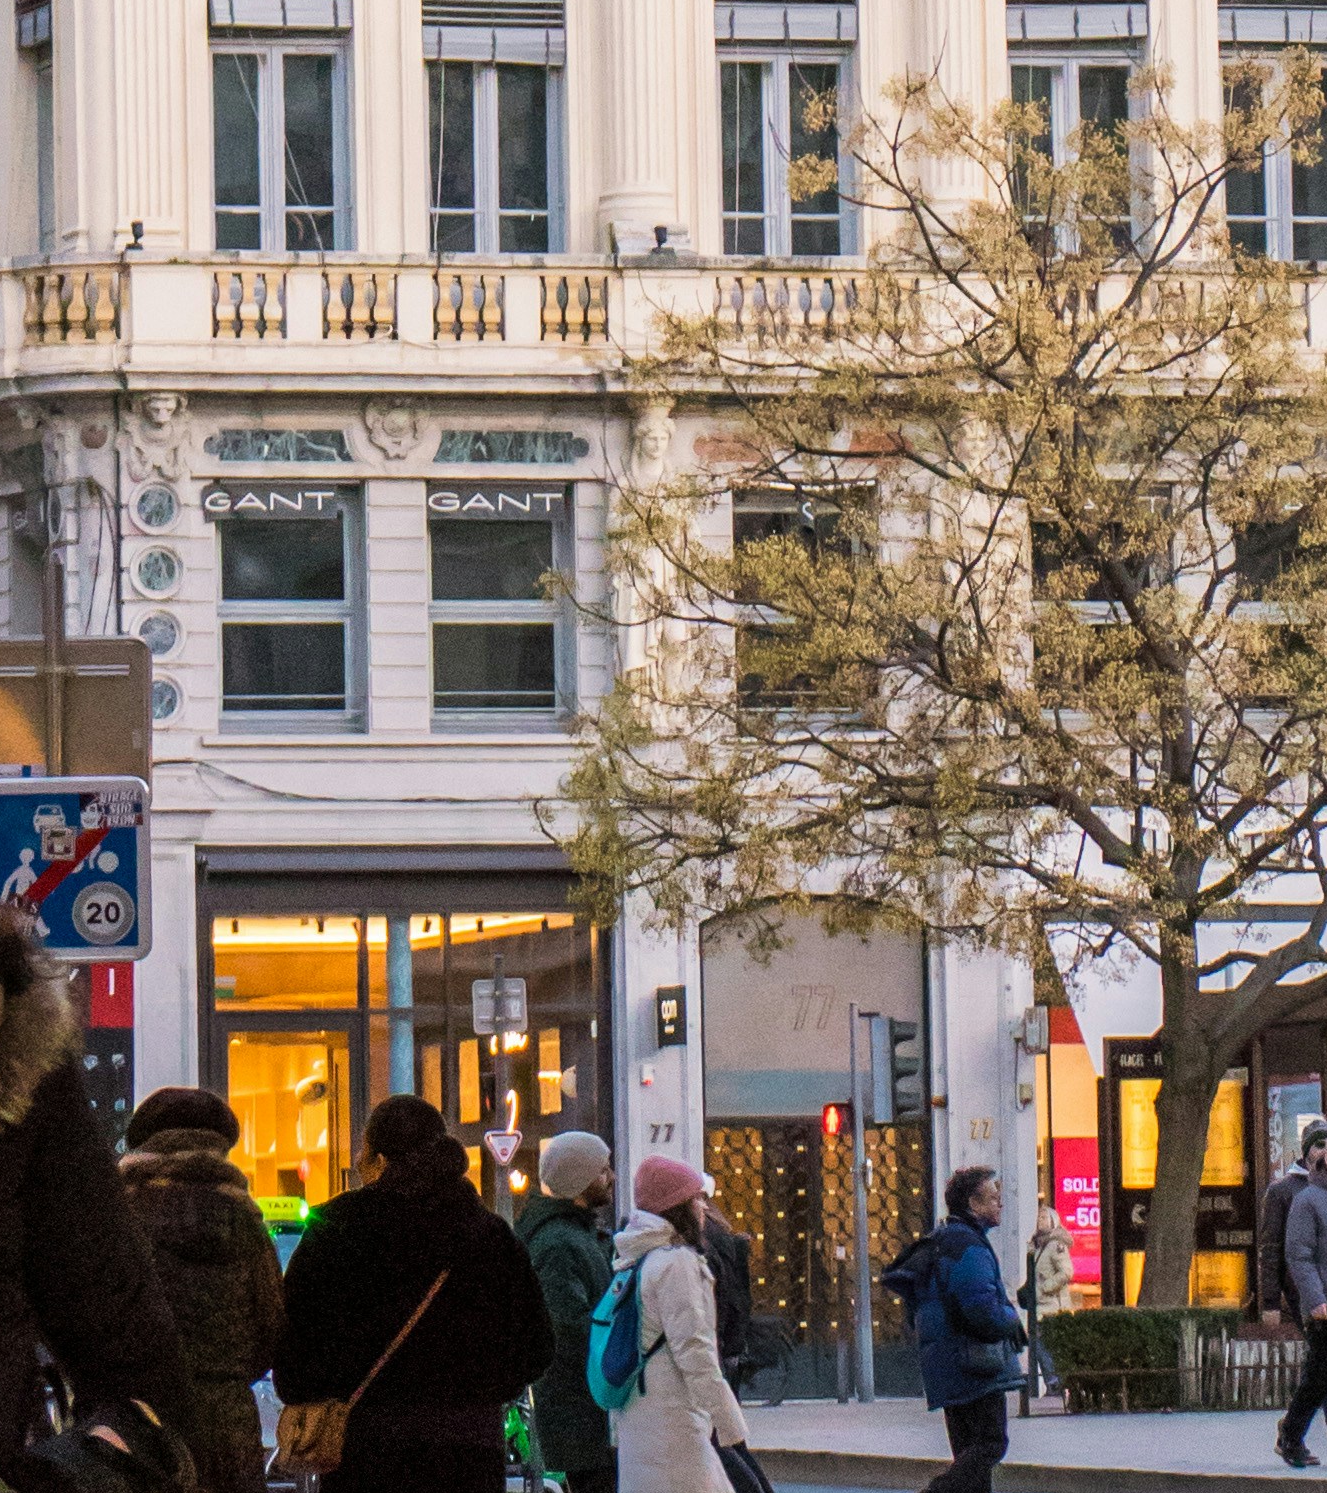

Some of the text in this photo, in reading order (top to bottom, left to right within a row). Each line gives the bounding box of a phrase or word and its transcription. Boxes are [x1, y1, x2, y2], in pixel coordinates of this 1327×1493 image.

[204, 491, 336, 512] GANT
[428, 491, 564, 513] GANT
[86, 901, 121, 925] 20
[650, 1122, 675, 1143] 77
[268, 1201, 294, 1209] TAXI
